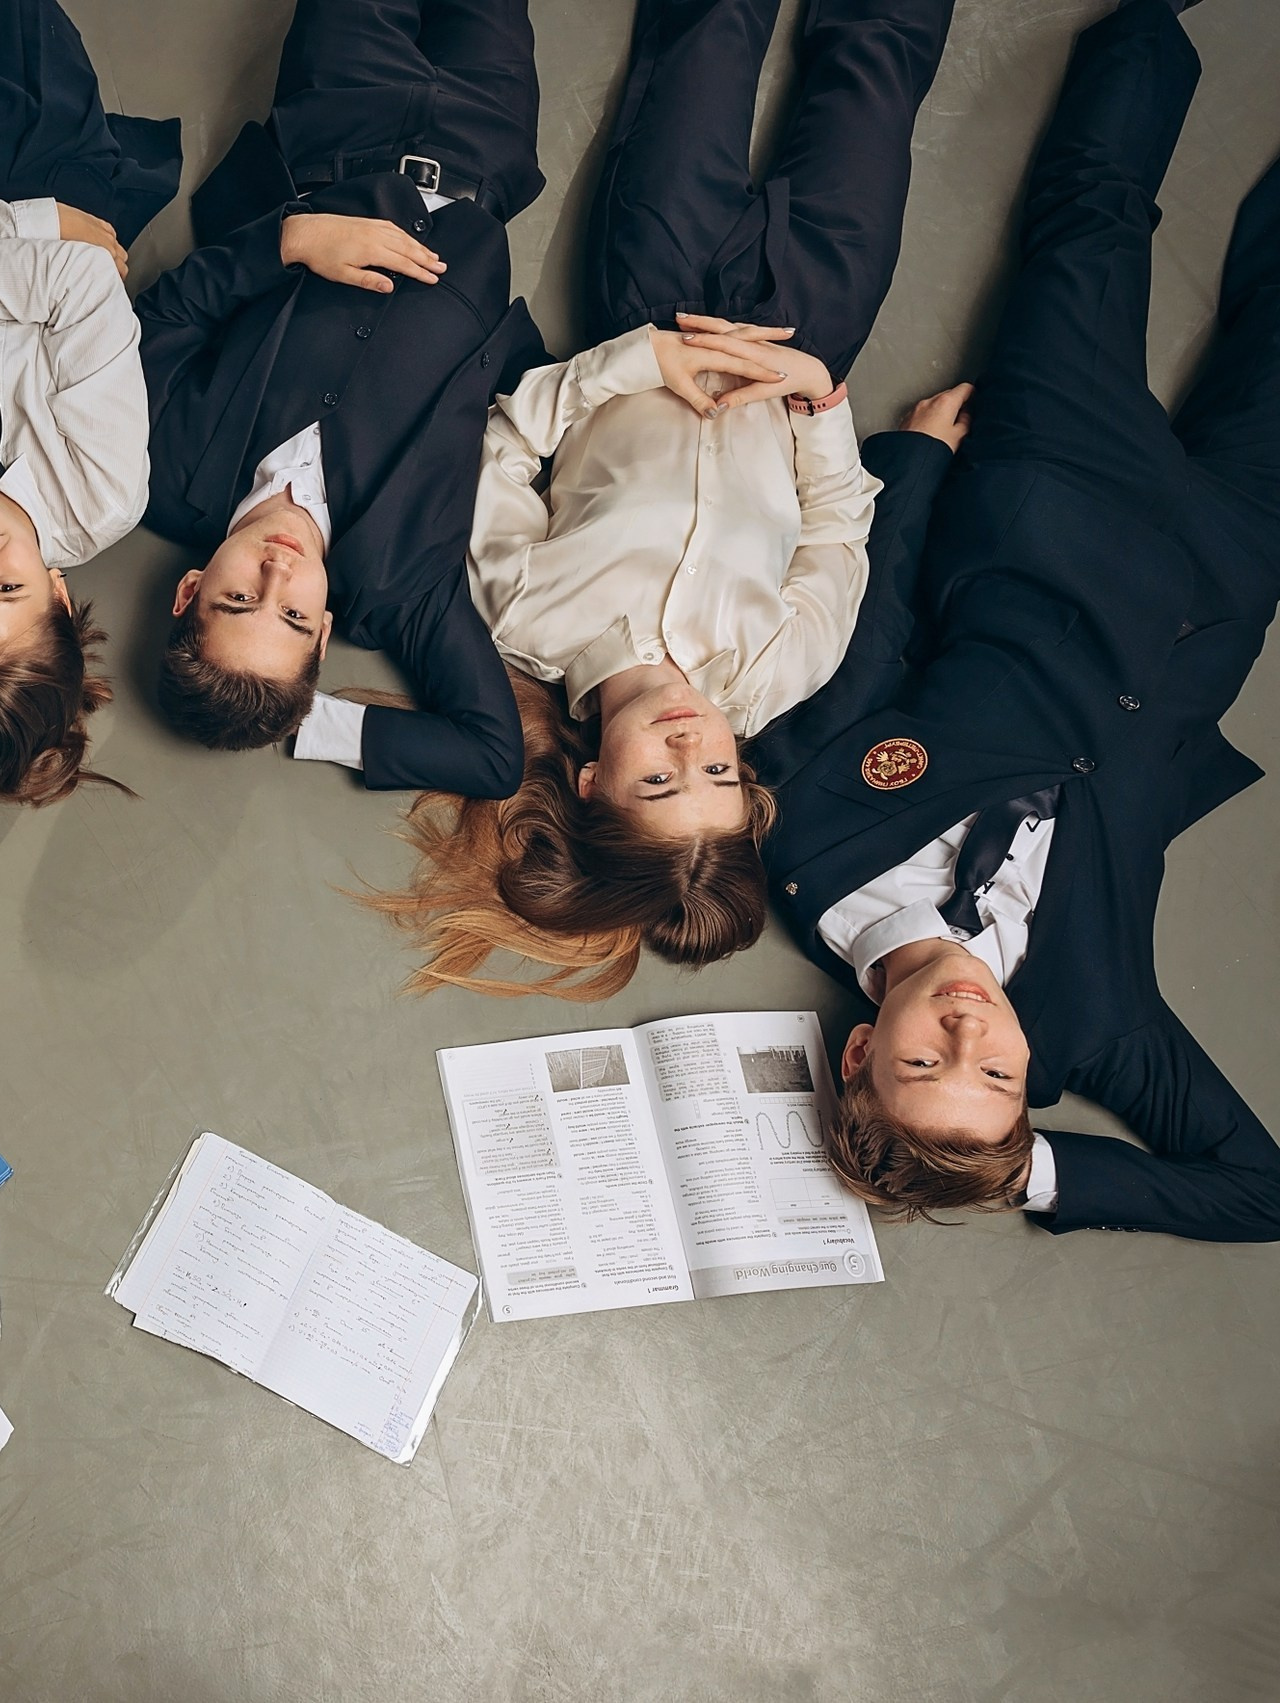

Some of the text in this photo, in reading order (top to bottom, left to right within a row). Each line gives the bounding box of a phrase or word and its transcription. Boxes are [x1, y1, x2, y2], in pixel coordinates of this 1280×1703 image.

[826, 1236, 854, 1245] Vocabulary
[848, 1255, 858, 1270] 5
[734, 1260, 837, 1279] Our Changing World
[652, 1284, 678, 1293] Grammar
